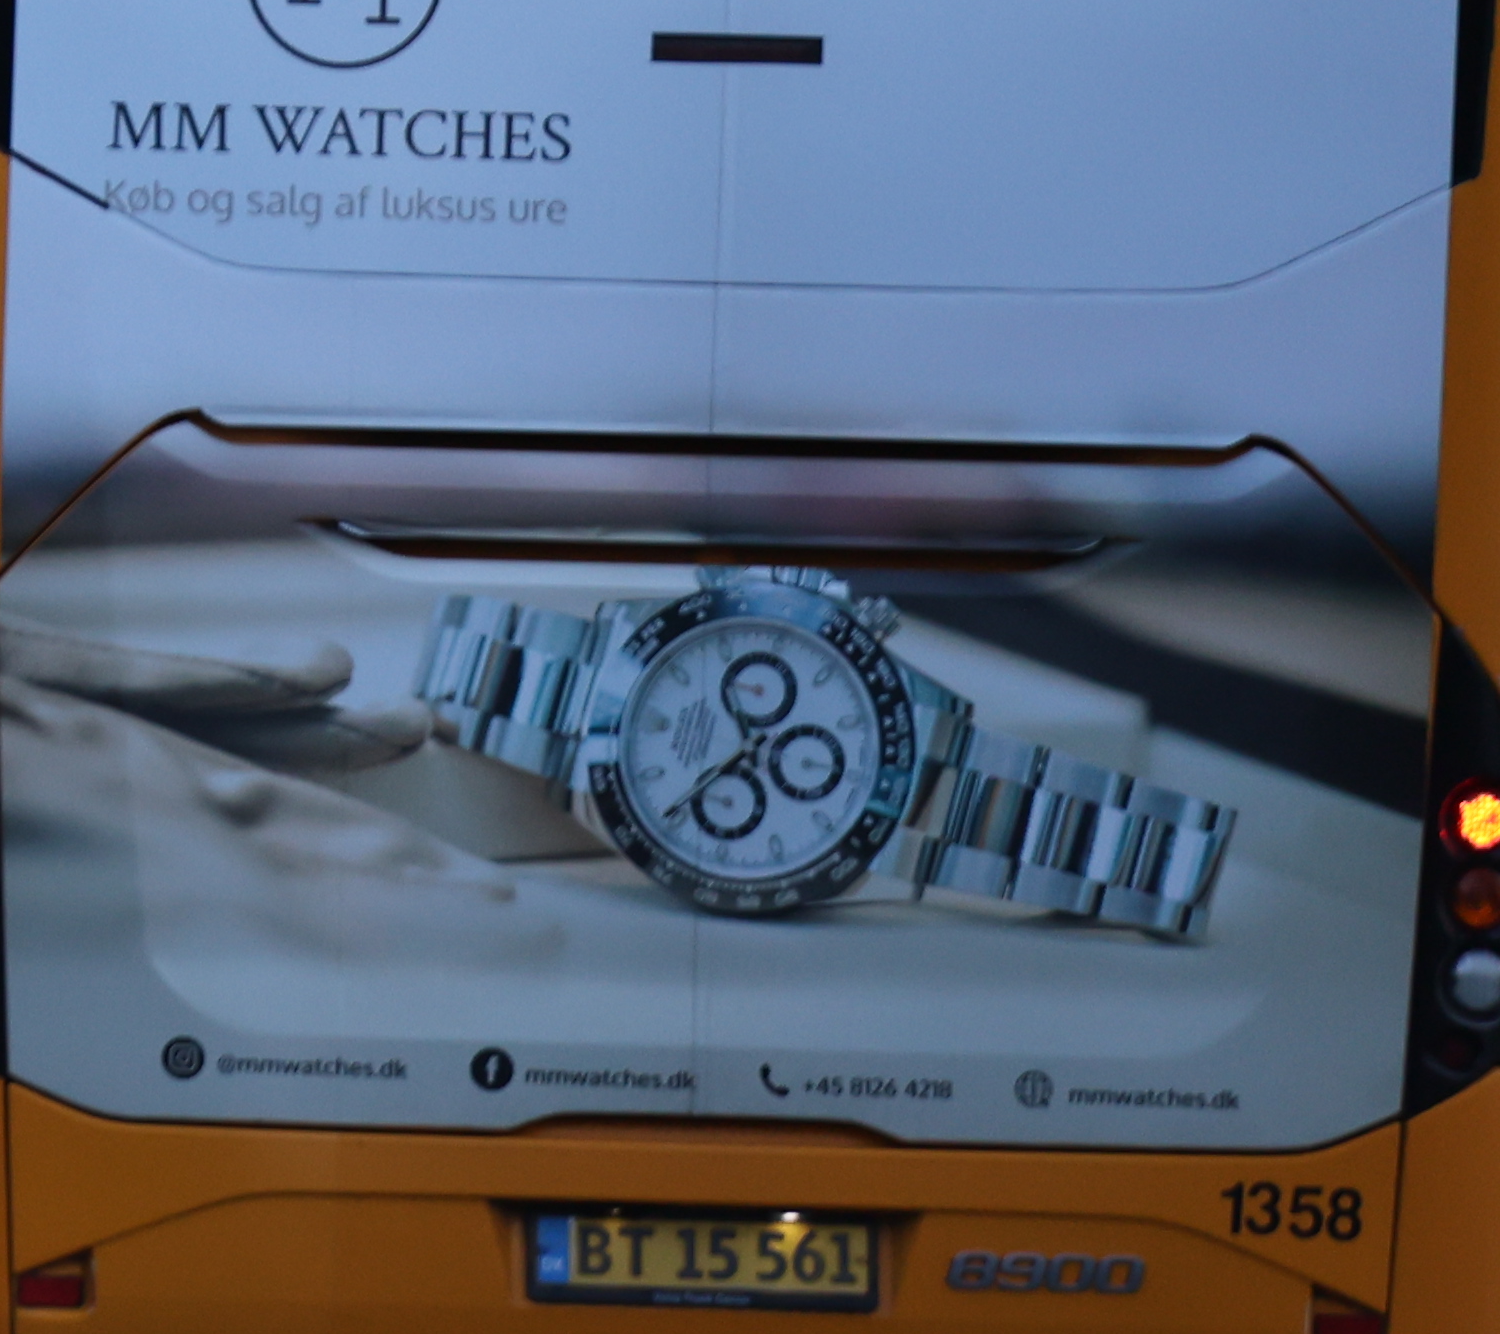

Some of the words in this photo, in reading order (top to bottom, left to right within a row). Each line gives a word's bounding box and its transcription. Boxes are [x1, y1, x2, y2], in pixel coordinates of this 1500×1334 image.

[106, 100, 231, 153] MM
[251, 104, 571, 162] WATCHES
[103, 179, 175, 213] Køb
[187, 187, 233, 225] og
[247, 184, 322, 225] salg
[335, 184, 371, 218] af
[382, 186, 496, 222] luksus
[508, 196, 567, 223] ure
[216, 1052, 407, 1079] @mmwatches.dk
[523, 1064, 696, 1090] mmwatches.dk
[804, 1077, 843, 1096] +45
[850, 1078, 897, 1097] 8126
[904, 1079, 953, 1099] 4218
[1068, 1085, 1240, 1110] mmwatches.dk
[1221, 1181, 1363, 1242] 1358
[579, 1227, 653, 1277] BT
[678, 1229, 739, 1281] 15
[756, 1230, 858, 1284] 561
[946, 1250, 1146, 1295] 8900
